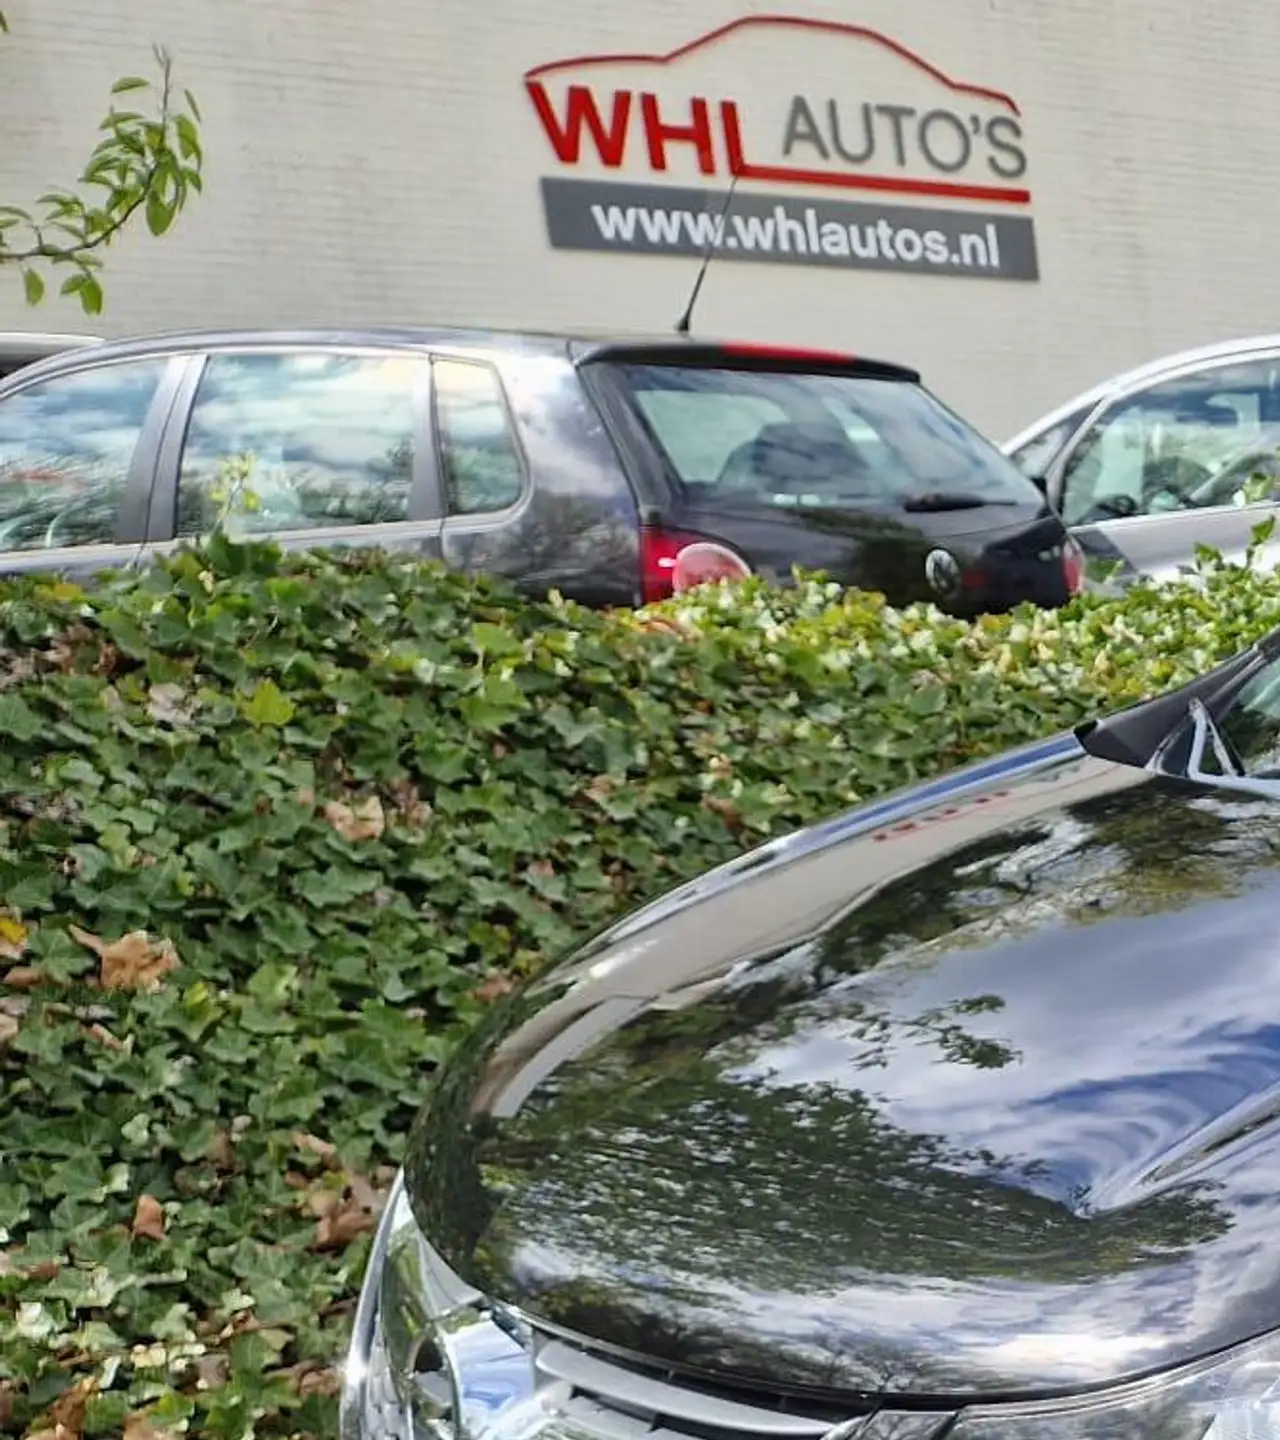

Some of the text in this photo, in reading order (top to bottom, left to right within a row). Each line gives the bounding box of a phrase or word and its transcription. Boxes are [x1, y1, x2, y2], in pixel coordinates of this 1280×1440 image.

[525, 80, 1028, 178] WHL AUTO'S
[590, 204, 1000, 267] www.whlautos.nl
